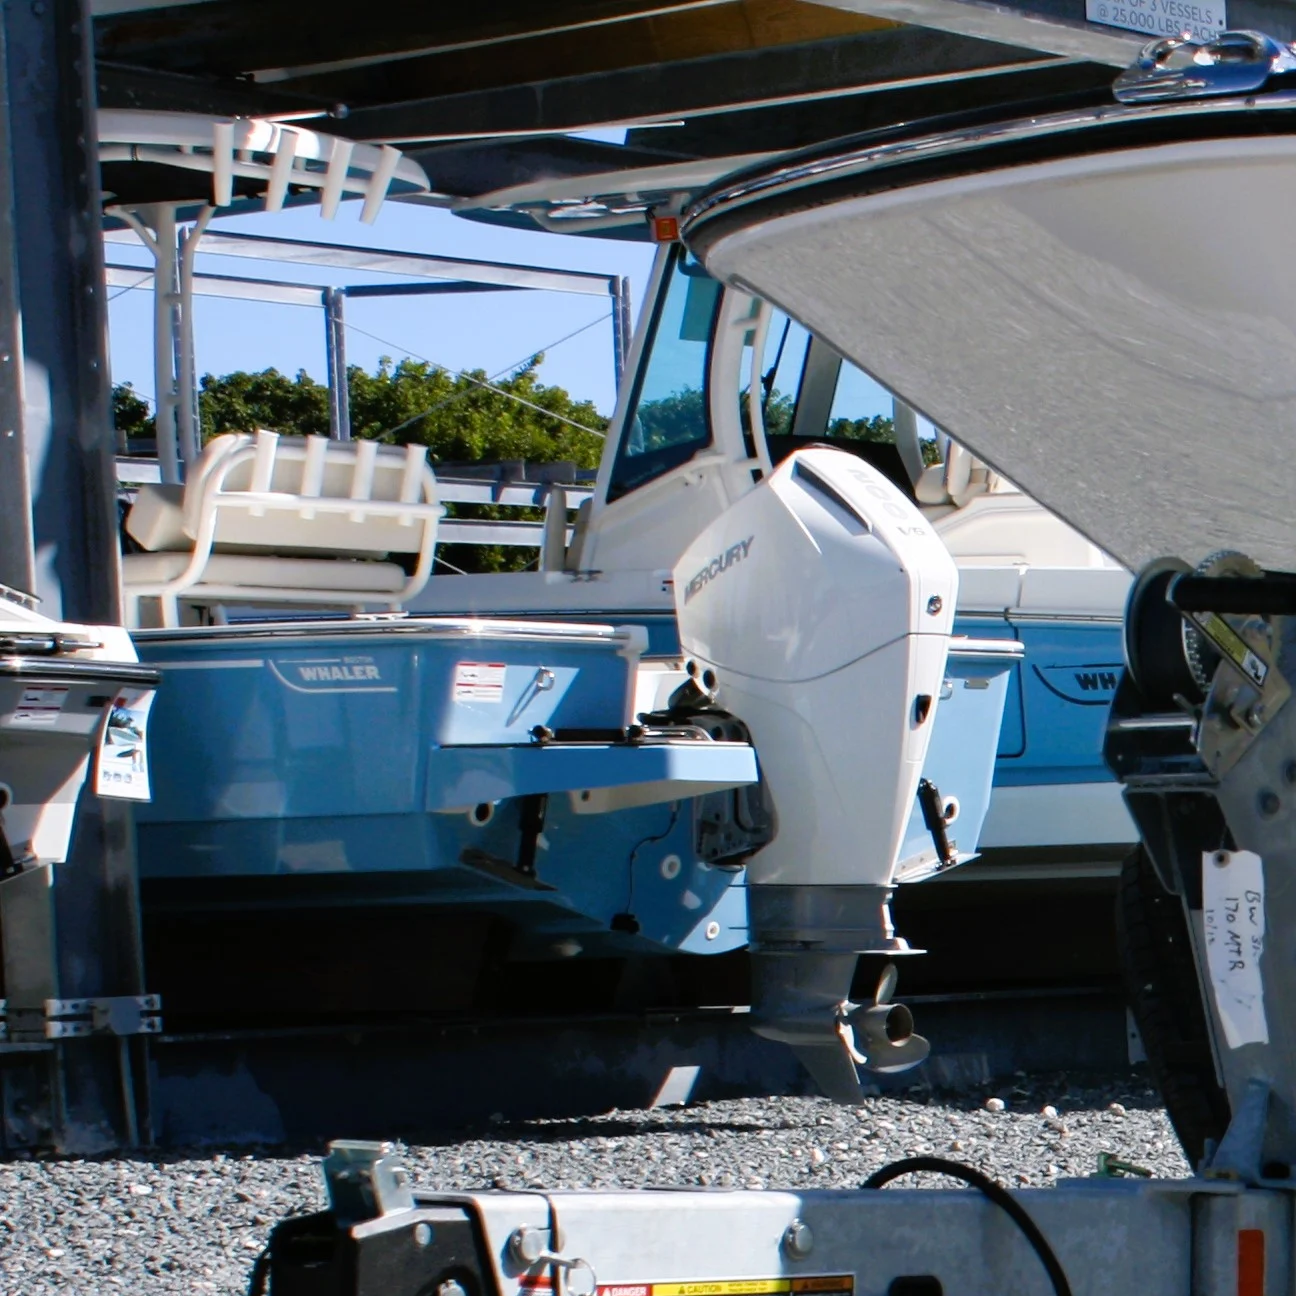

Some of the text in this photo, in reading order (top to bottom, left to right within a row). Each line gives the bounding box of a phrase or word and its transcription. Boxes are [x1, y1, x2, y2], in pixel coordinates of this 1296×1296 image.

[1097, 4, 1109, 20] @
[1112, 7, 1156, 30] 25,000
[1158, 17, 1181, 34] LBS
[1161, 2, 1213, 25] VESSELS
[298, 665, 381, 681] WHALER
[612, 1286, 647, 1296] DANGER
[687, 1284, 722, 1294] CAUTION
